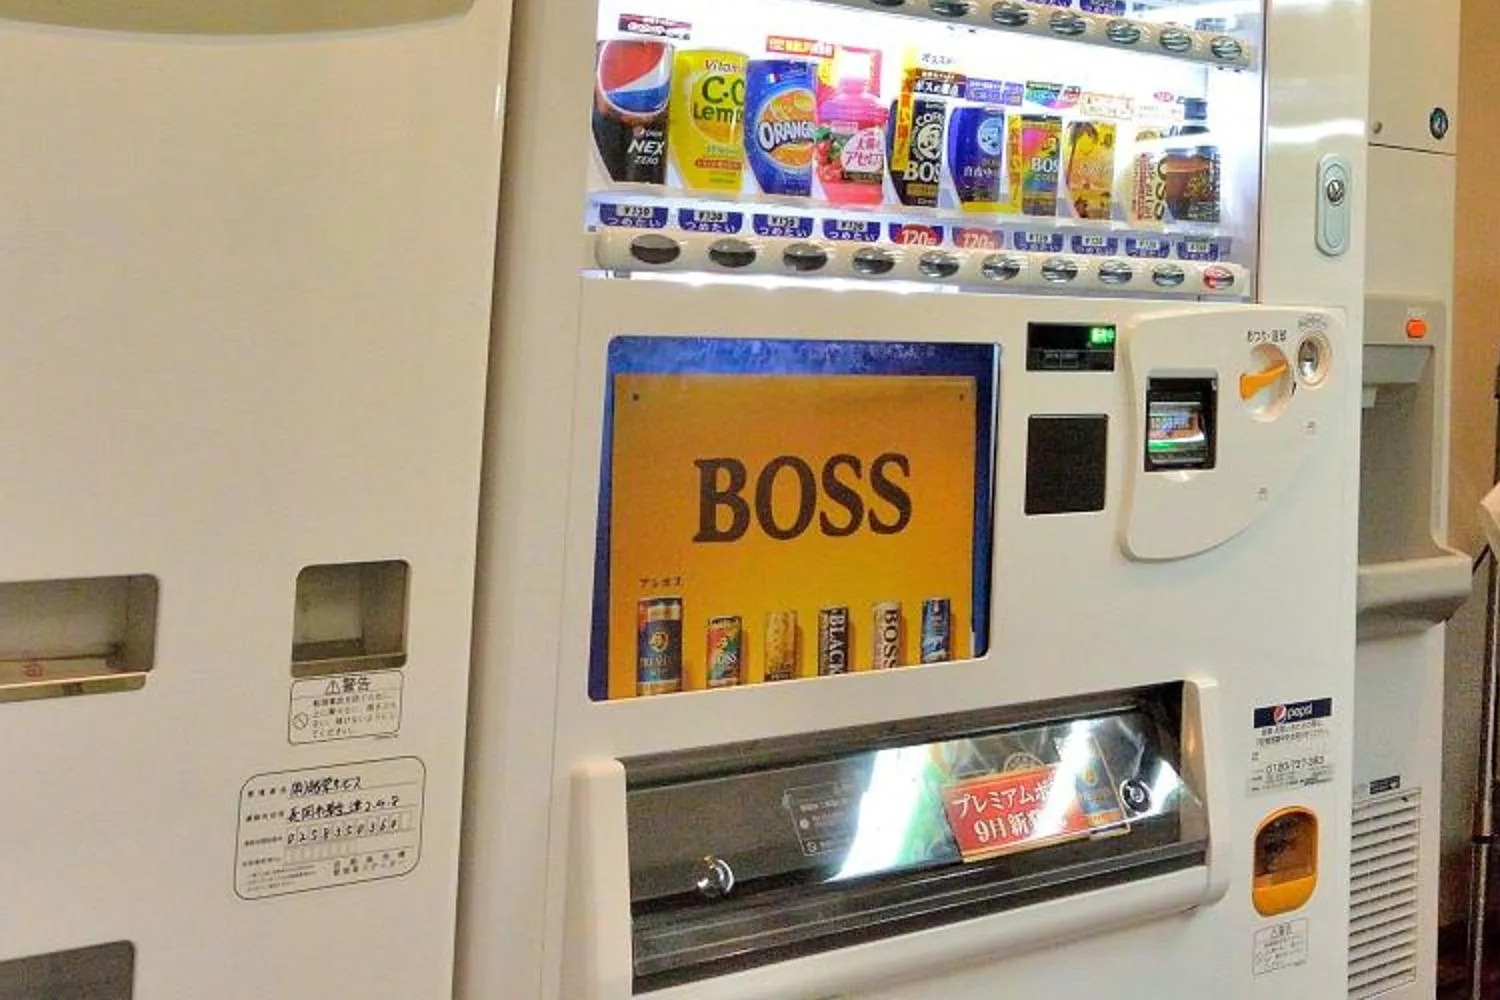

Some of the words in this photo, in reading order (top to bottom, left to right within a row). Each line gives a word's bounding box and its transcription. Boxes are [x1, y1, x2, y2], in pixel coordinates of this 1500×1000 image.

[628, 140, 665, 155] NEX
[693, 453, 913, 543] BOSS
[884, 609, 898, 669] BOSS
